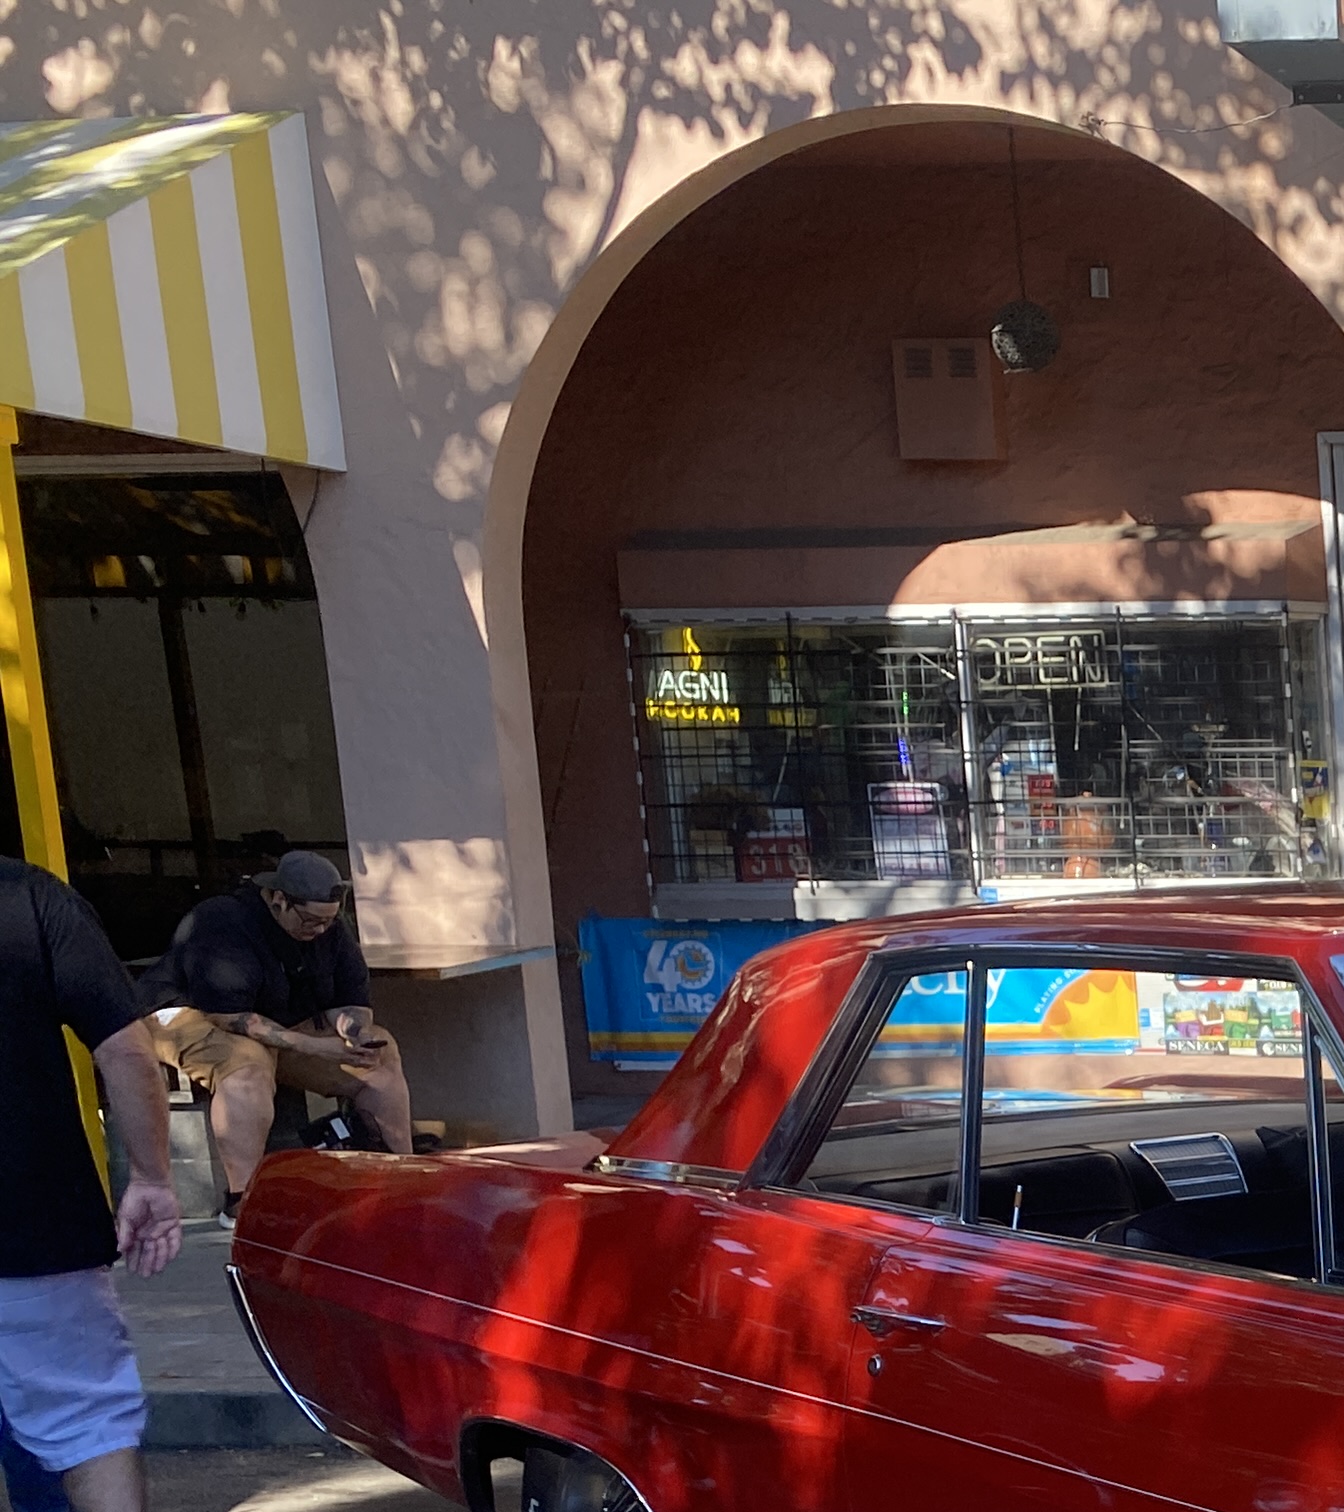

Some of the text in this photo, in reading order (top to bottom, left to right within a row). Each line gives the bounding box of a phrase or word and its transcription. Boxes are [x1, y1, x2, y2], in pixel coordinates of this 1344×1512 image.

[975, 635, 1102, 683] OPEN
[657, 668, 730, 704] AGNI
[646, 697, 741, 725] HOOKAH
[643, 939, 716, 992] 40
[645, 991, 717, 1013] YEARS
[1033, 976, 1064, 1013] PLAYING
[1168, 1040, 1225, 1052] SENECA
